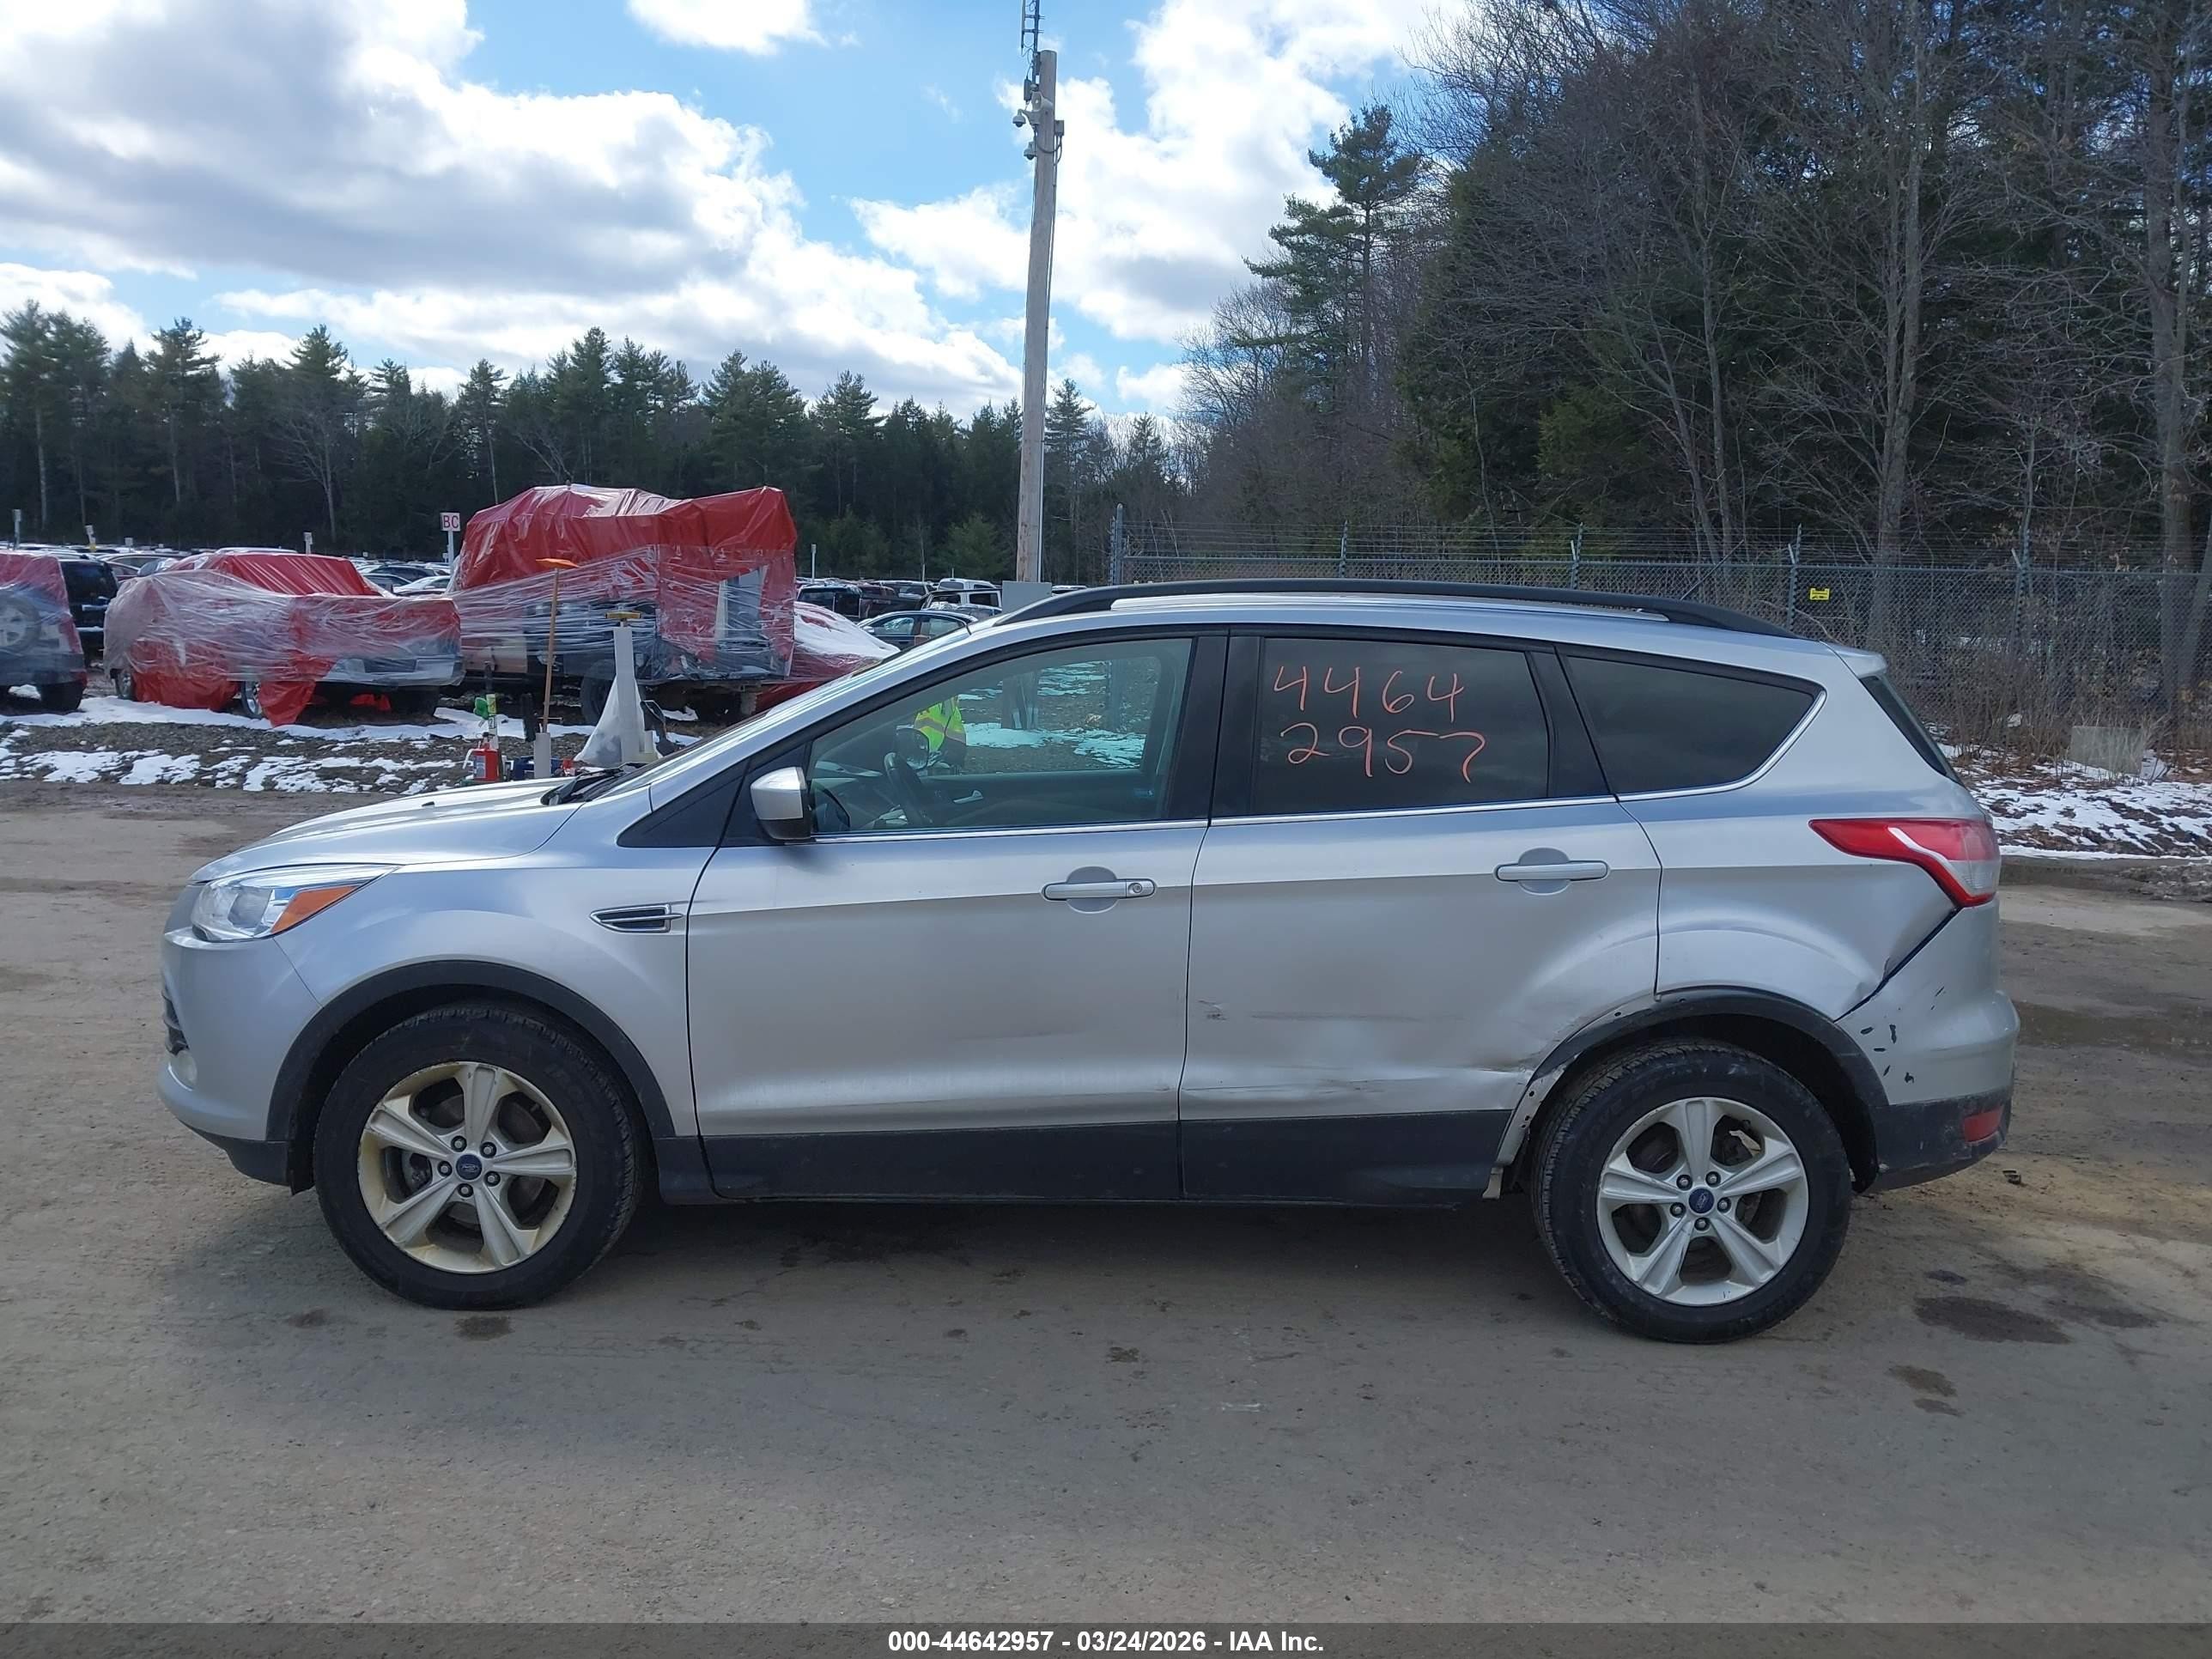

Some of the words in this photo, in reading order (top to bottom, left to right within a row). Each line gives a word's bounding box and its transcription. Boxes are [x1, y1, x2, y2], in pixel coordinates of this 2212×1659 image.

[443, 515, 459, 529] BC
[1273, 665, 1465, 723] 4464
[1279, 722, 1486, 783] 2957
